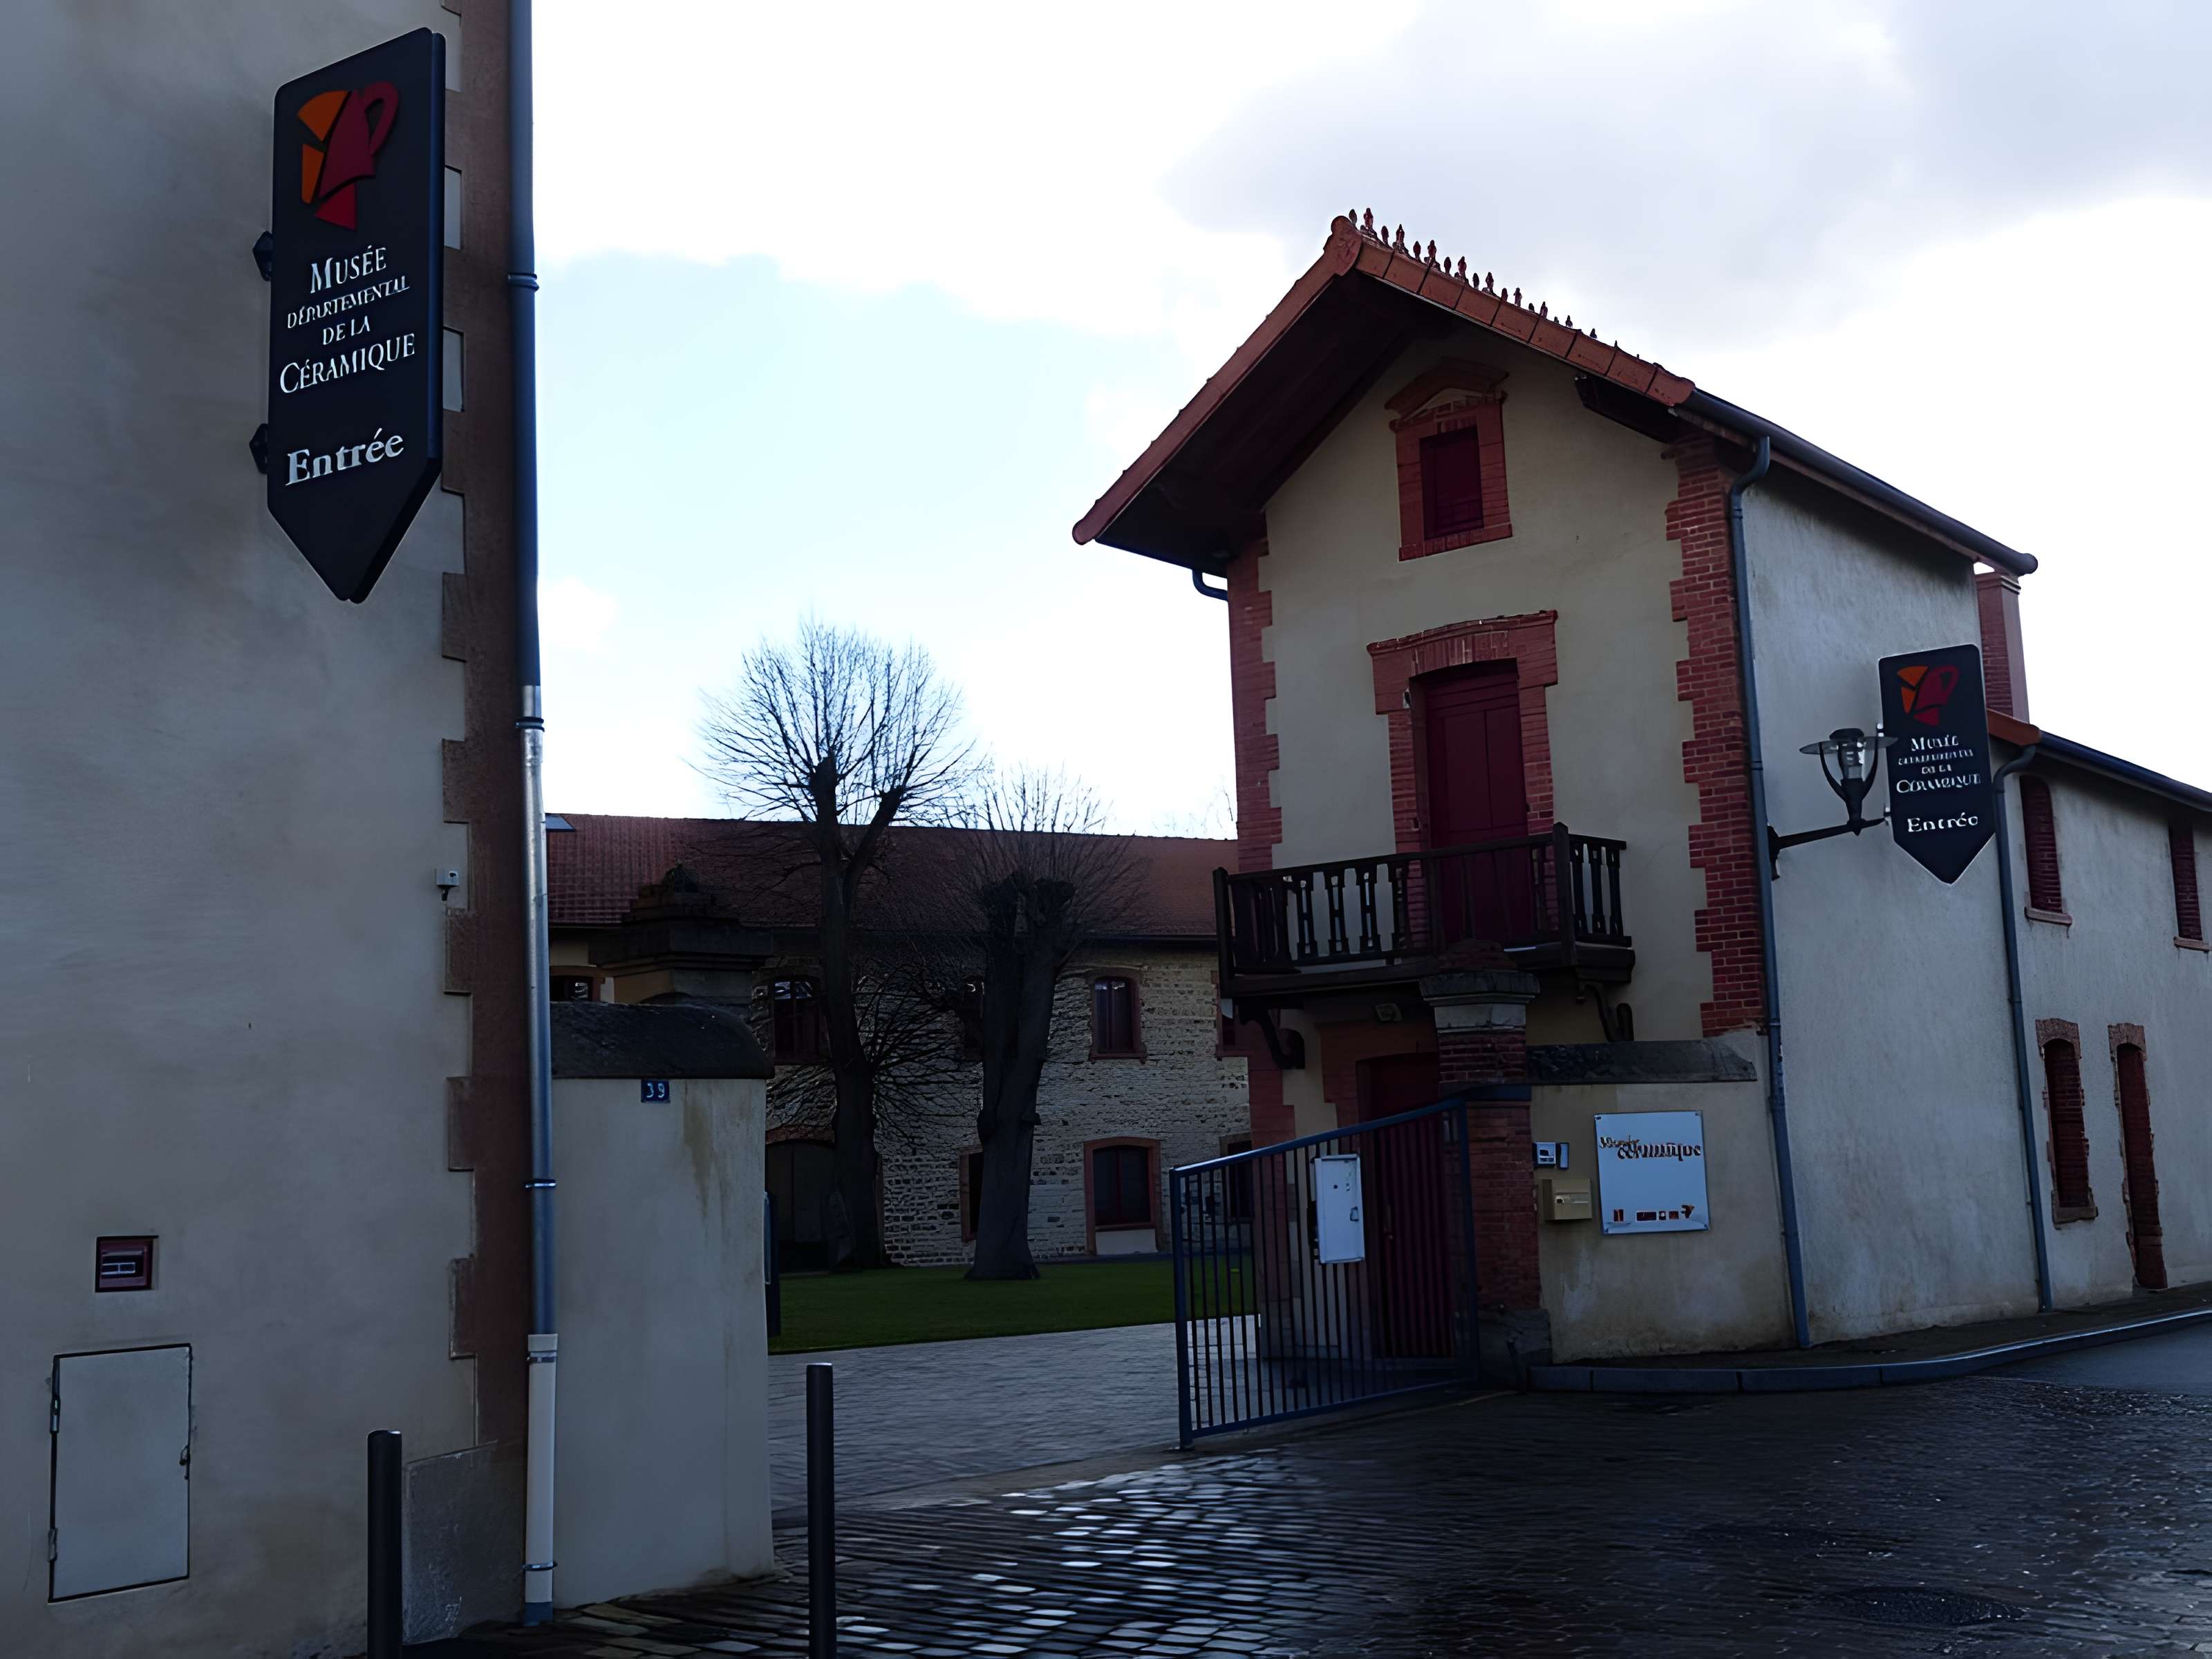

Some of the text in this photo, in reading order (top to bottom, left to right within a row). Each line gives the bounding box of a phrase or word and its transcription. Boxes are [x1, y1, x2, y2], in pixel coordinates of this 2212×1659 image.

[310, 244, 387, 294] MUSÉE
[322, 315, 371, 346] DE LA
[279, 332, 415, 393] CÉRAMIQUE
[285, 427, 404, 486] Entrée
